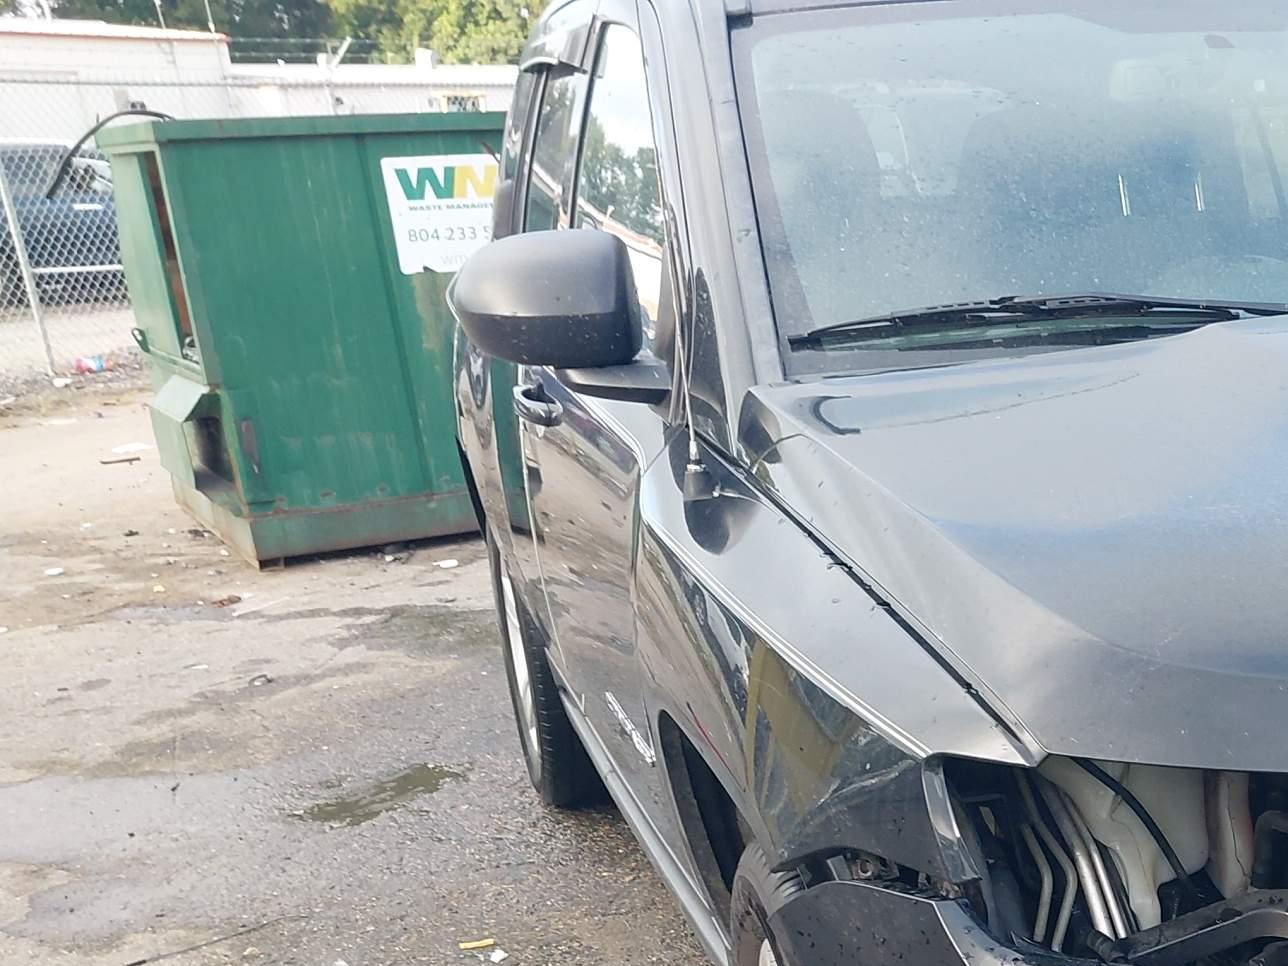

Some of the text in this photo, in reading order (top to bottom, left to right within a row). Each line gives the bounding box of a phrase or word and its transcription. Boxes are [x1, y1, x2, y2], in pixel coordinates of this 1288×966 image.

[408, 204, 443, 212] WASTE
[407, 229, 440, 243] 804
[444, 226, 478, 241] 233
